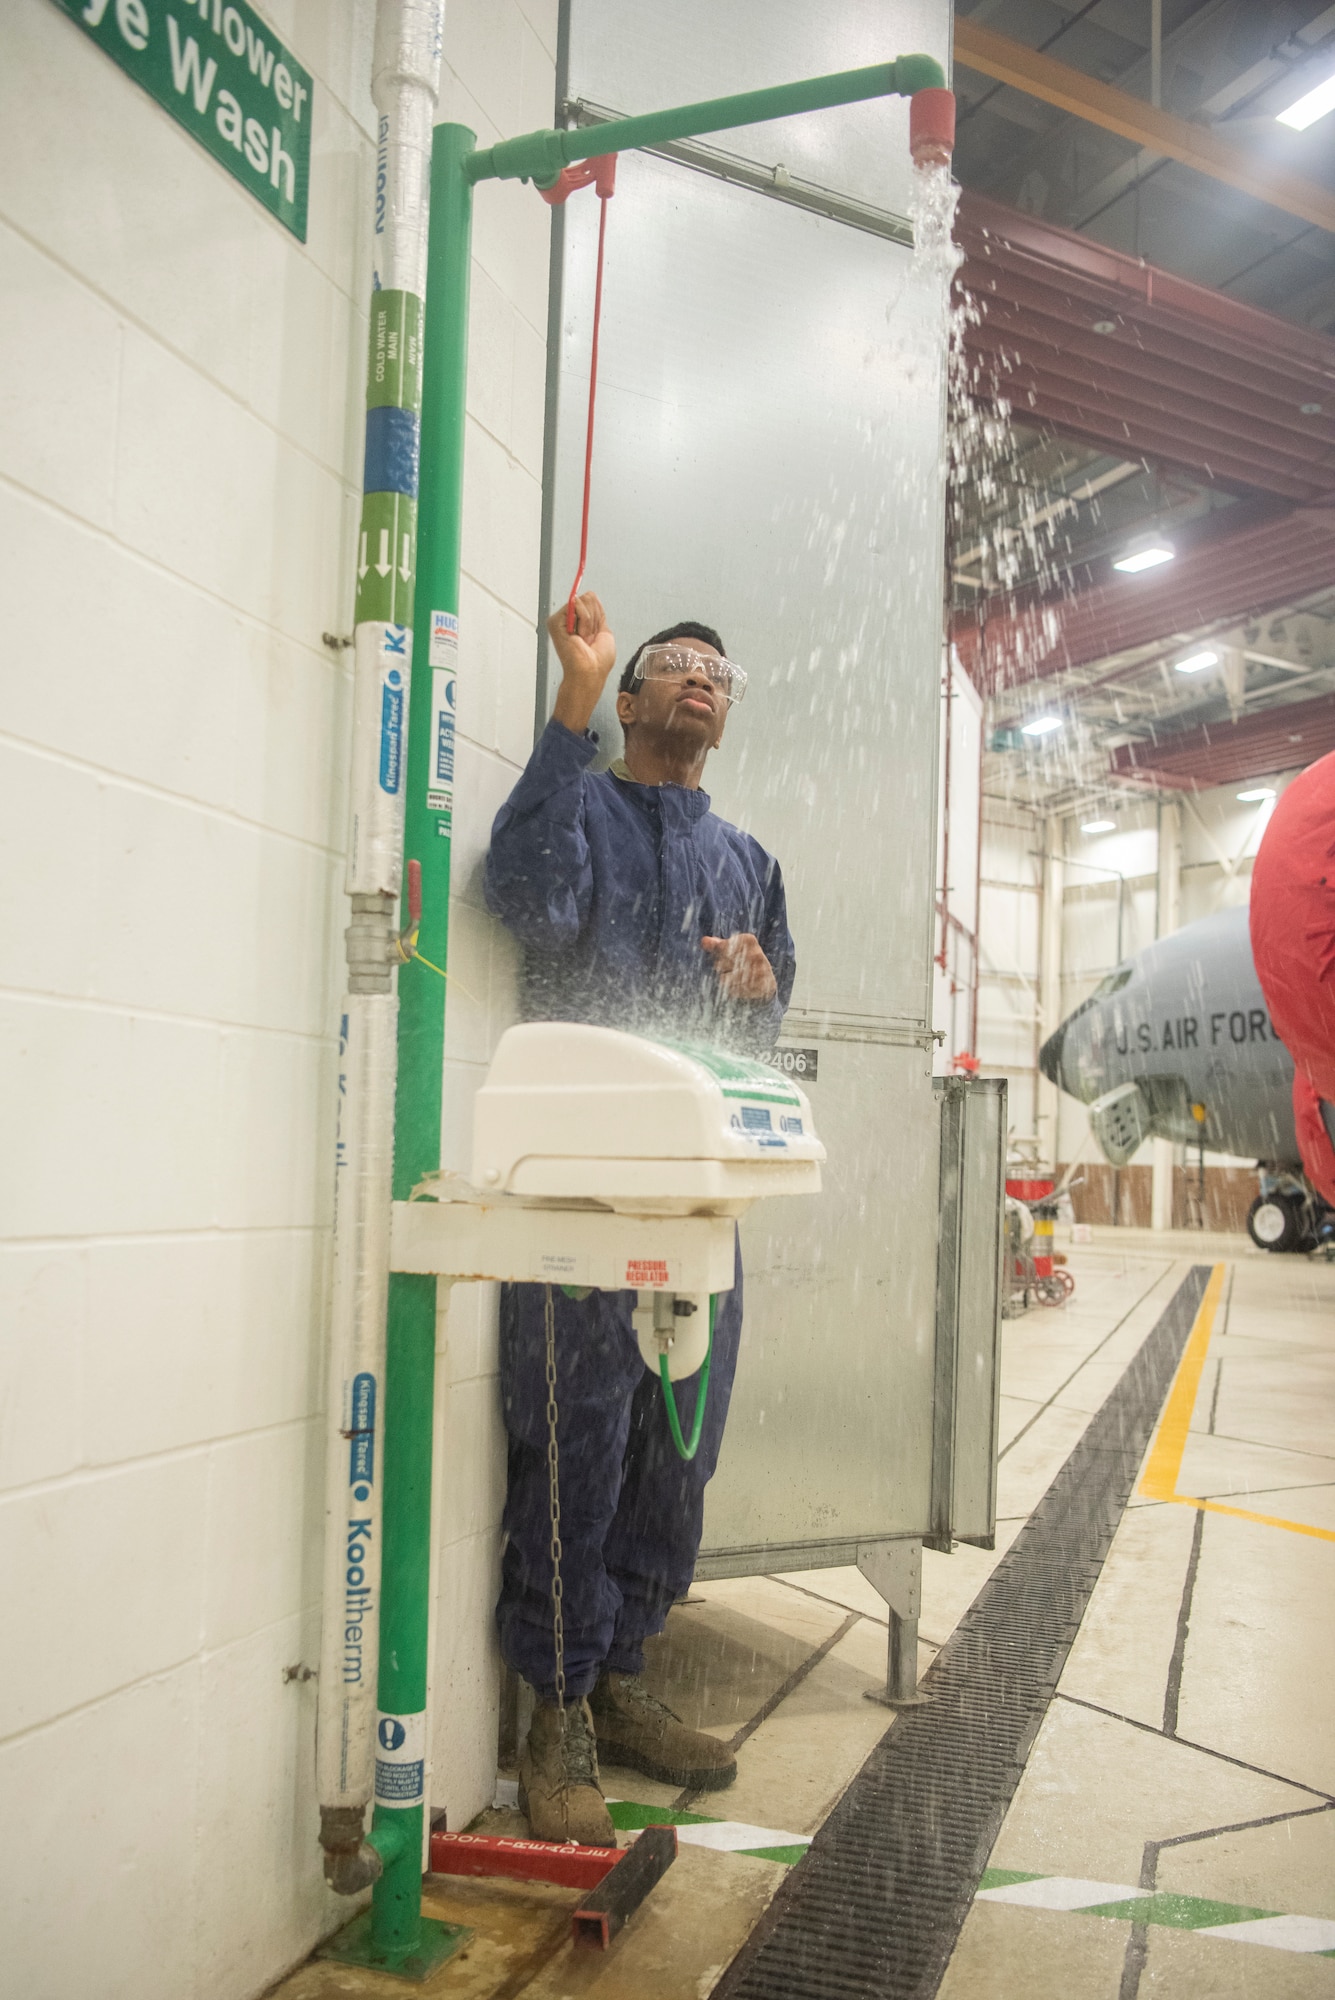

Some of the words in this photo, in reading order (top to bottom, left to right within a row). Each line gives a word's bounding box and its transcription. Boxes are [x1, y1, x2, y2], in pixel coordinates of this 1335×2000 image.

[166, 13, 295, 204] Wash
[377, 310, 387, 350] WATER
[387, 331, 399, 360] MAIN
[375, 351, 385, 383] COLD
[385, 623, 406, 655] K
[386, 732, 400, 788] Kingspan
[760, 1052, 807, 1073] 2406
[625, 1271, 669, 1282] REGULATOR
[627, 1259, 667, 1271] PRESSURE
[343, 1518, 373, 1684] Kooltherm
[497, 1839, 610, 1858] TREADLE
